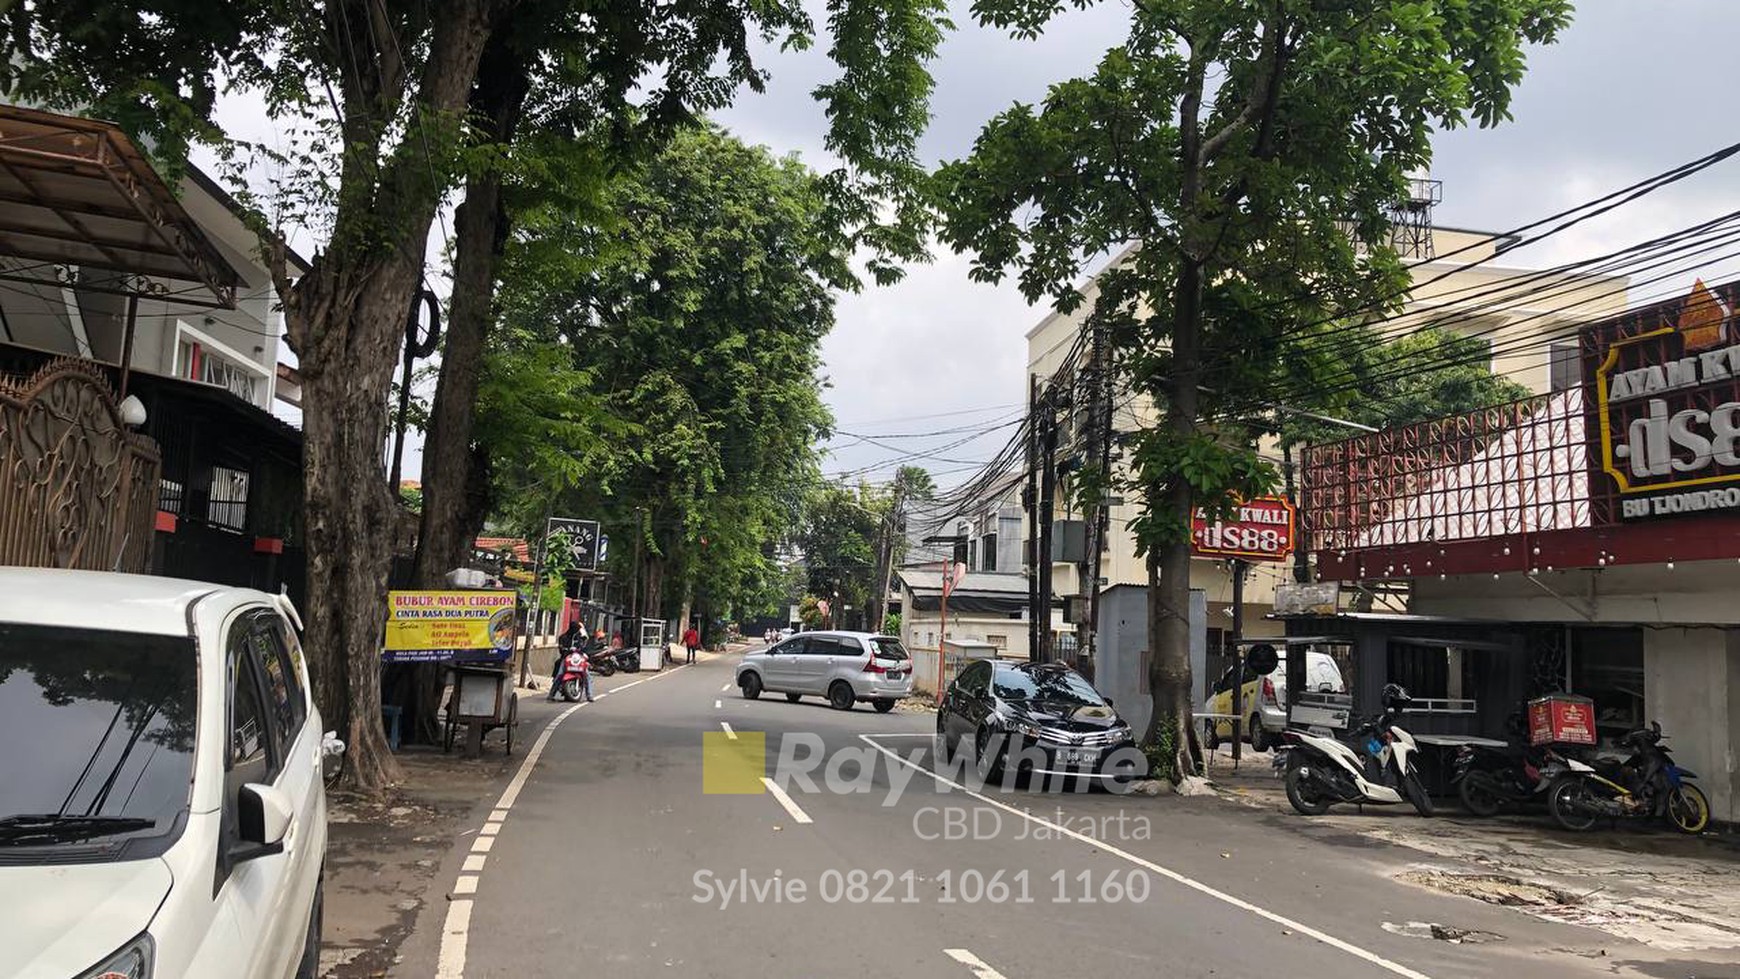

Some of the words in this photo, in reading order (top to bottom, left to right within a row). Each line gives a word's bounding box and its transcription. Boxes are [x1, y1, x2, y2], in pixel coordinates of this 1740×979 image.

[1608, 357, 1699, 403] AYAM
[1239, 507, 1288, 525] KWALI
[1622, 499, 1650, 518] BU
[396, 596, 434, 607] BUBUR
[437, 596, 466, 606] AYAM
[469, 596, 514, 606] CIREBON
[396, 610, 420, 618] CINTA
[422, 610, 442, 618] RASA
[445, 610, 462, 618] DUA
[464, 610, 489, 618] PUTRA
